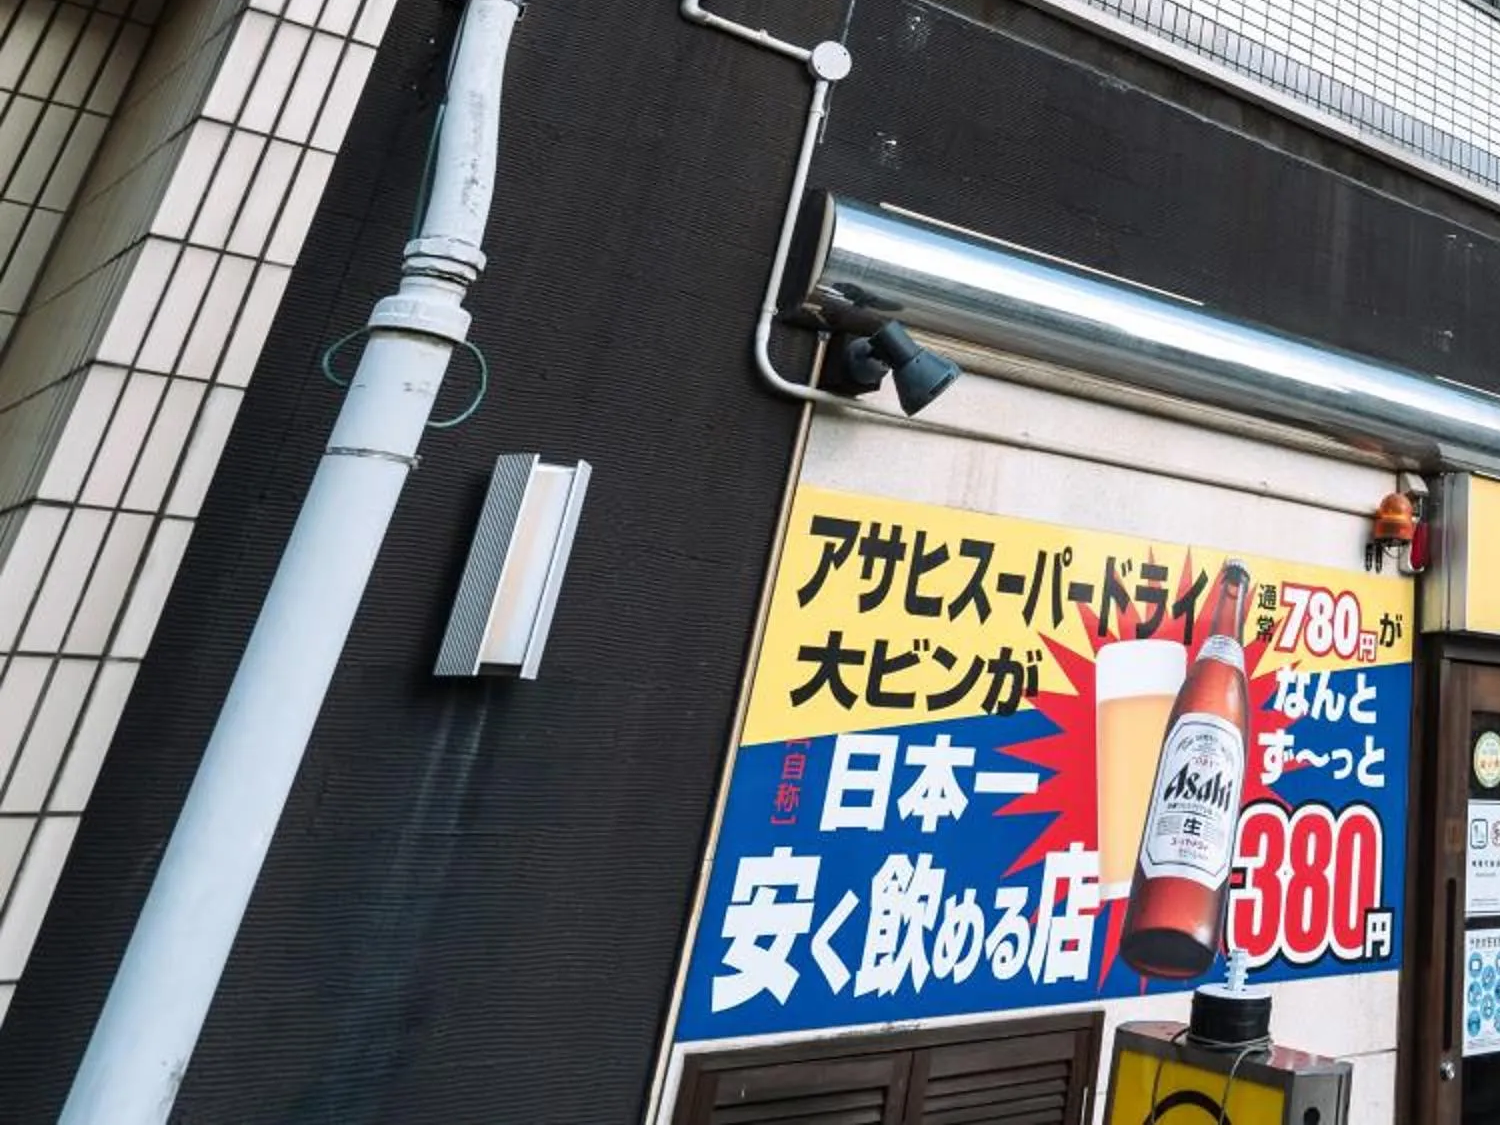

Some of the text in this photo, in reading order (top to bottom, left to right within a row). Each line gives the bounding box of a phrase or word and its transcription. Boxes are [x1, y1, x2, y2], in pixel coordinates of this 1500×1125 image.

[796, 515, 1209, 646] アサヒスーパードライ
[1257, 584, 1277, 642] 通常
[790, 631, 1042, 715] 大ビンが
[1273, 665, 1377, 724] なんと
[819, 734, 1040, 833] 日本一
[1163, 763, 1232, 812] Asahi
[1183, 817, 1203, 836] 生
[1228, 802, 1392, 968] 380円
[711, 843, 1101, 1013] 安く飲める店
